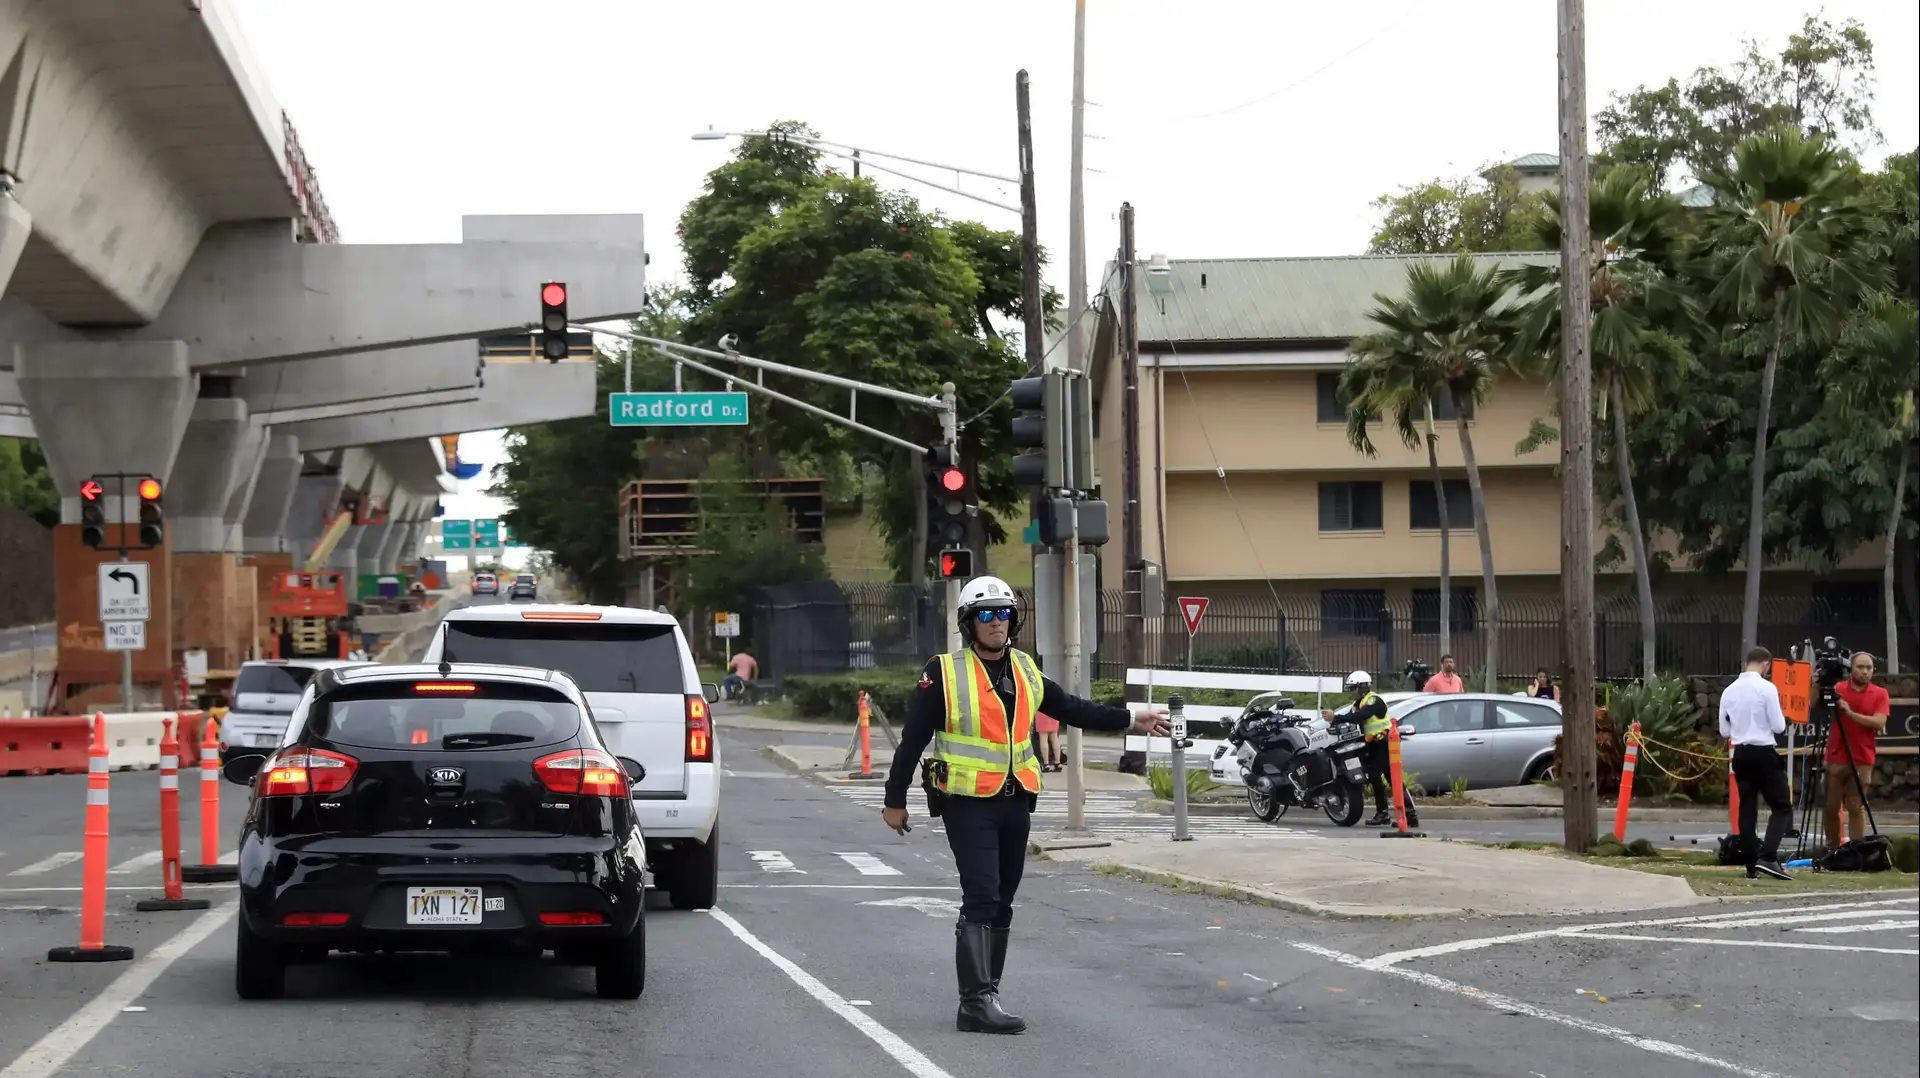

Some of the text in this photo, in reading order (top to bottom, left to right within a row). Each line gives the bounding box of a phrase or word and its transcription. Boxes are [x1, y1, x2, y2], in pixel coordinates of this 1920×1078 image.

[621, 399, 743, 418] Radford Dr.
[109, 624, 141, 636] NO U
[437, 771, 456, 780] KIA
[411, 896, 478, 915] TXN 127
